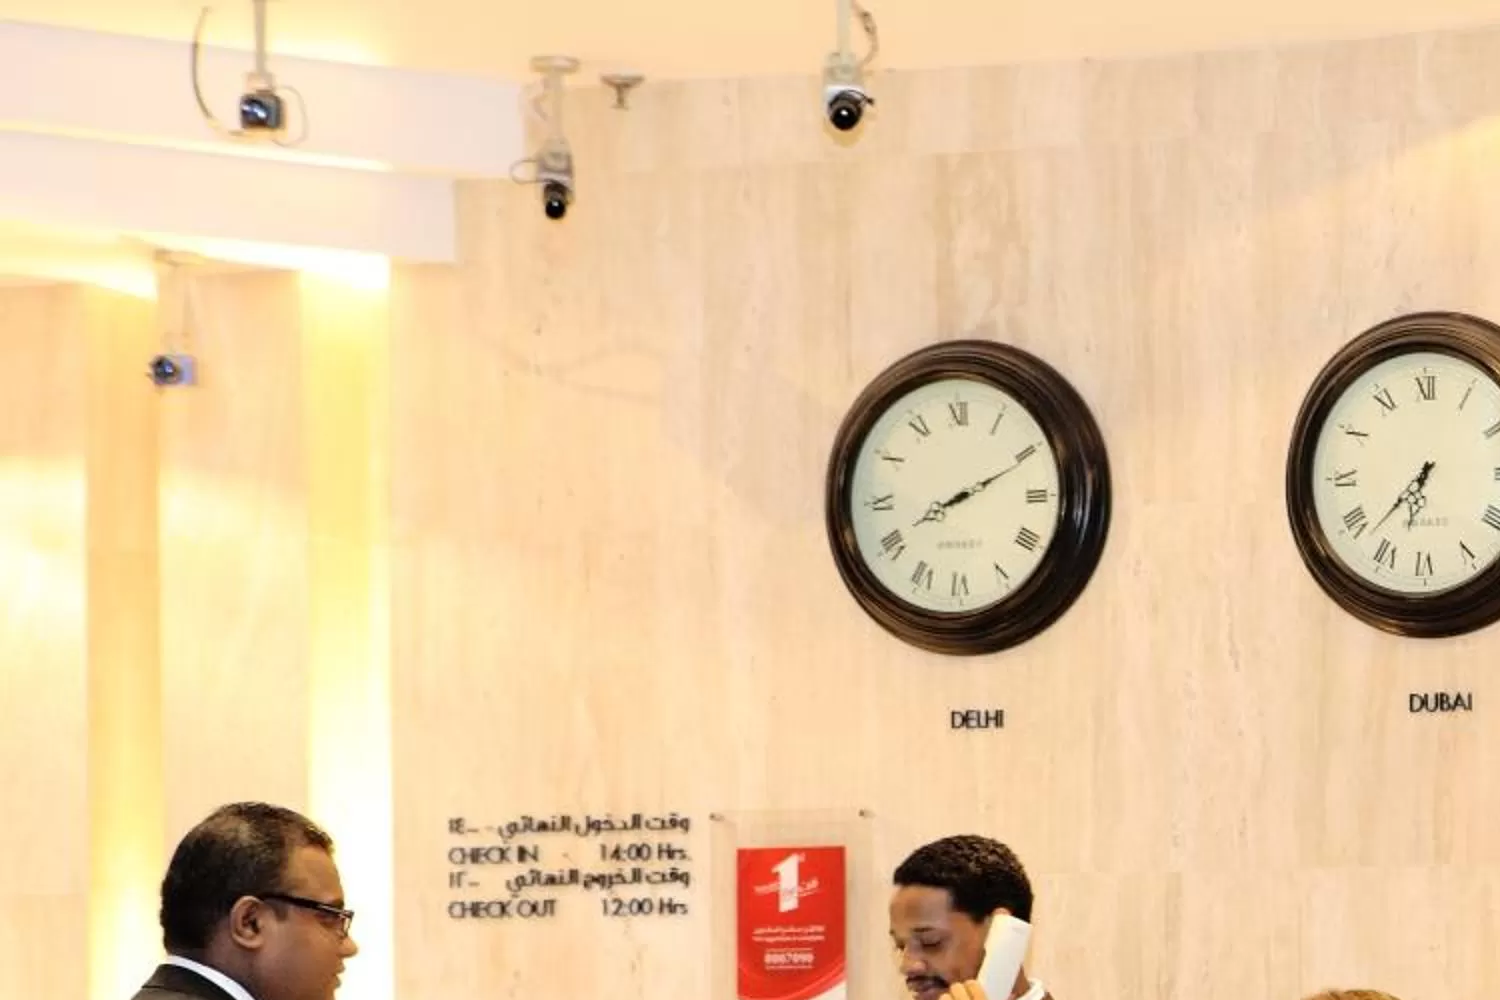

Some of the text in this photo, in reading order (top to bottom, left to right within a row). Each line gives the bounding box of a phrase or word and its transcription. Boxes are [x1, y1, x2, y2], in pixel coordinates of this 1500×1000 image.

[1409, 692, 1473, 713] DUBAI
[951, 709, 1004, 729] DELHI
[645, 813, 690, 834] وقت
[448, 845, 512, 865] CHECK
[517, 843, 539, 863] IN
[600, 843, 652, 861] 14:00
[645, 867, 690, 888] وقت
[448, 899, 513, 918] CHECK
[517, 899, 557, 917] OUT
[601, 898, 654, 916] 12:00
